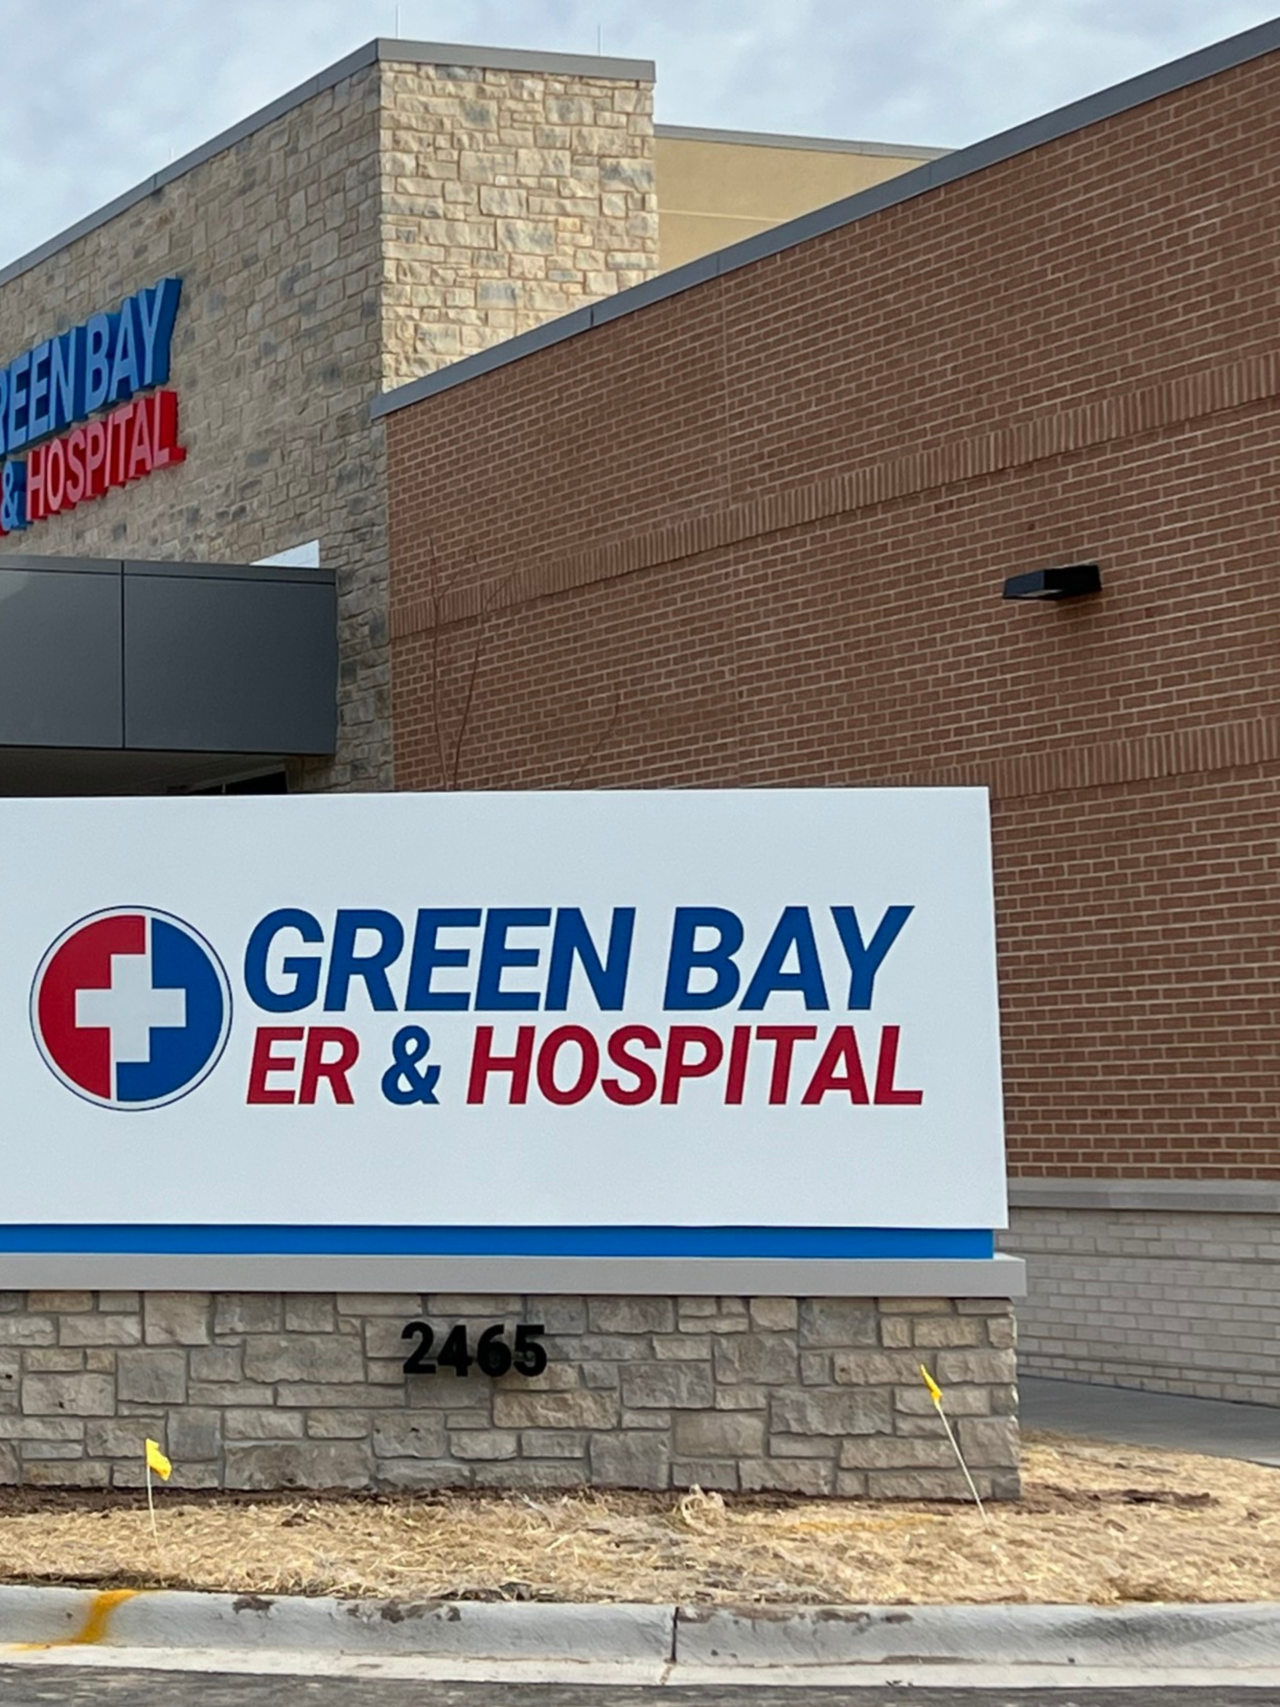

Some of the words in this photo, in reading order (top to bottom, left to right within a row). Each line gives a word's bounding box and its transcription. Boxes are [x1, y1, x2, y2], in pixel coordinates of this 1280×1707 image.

[84, 278, 182, 413] BAY
[0, 462, 27, 531] &
[25, 391, 186, 523] HOSPITAL
[243, 906, 637, 1013] GREEN
[662, 904, 915, 1011] BAY
[246, 1025, 360, 1105] ER
[380, 1025, 441, 1106] &
[466, 1024, 924, 1106] HOSPITAL
[401, 1321, 548, 1378] 2465
